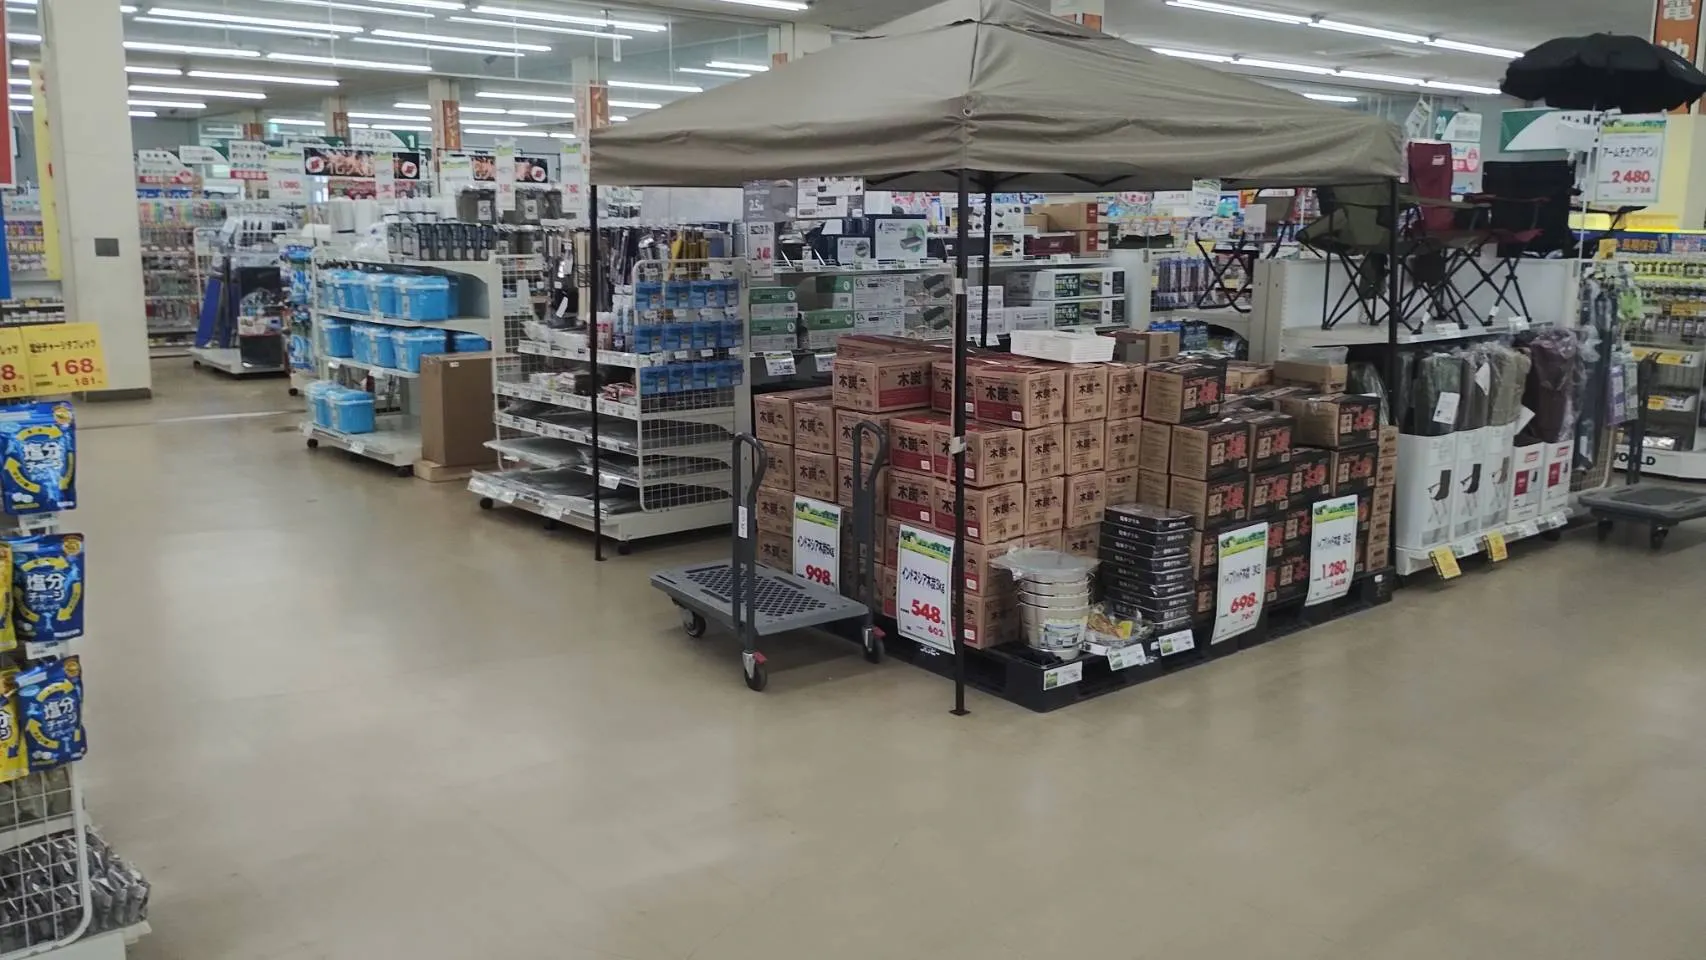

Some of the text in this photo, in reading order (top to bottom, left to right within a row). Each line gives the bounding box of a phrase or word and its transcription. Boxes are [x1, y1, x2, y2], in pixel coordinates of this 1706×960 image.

[51, 358, 94, 376] 168
[839, 374, 858, 389] 木炭
[897, 370, 923, 387] 木炭
[986, 385, 1009, 401] 木炭
[760, 411, 775, 425] 木炭
[800, 418, 816, 433] 木炭
[899, 436, 918, 452] 木炭
[800, 466, 817, 481] 木炭
[898, 485, 919, 501] 木炭
[27, 573, 65, 591] 塩分
[805, 564, 831, 586] 998
[28, 591, 65, 602] チャージ
[1230, 592, 1256, 613] 698
[911, 599, 941, 624] 548
[44, 697, 74, 720] 塩分
